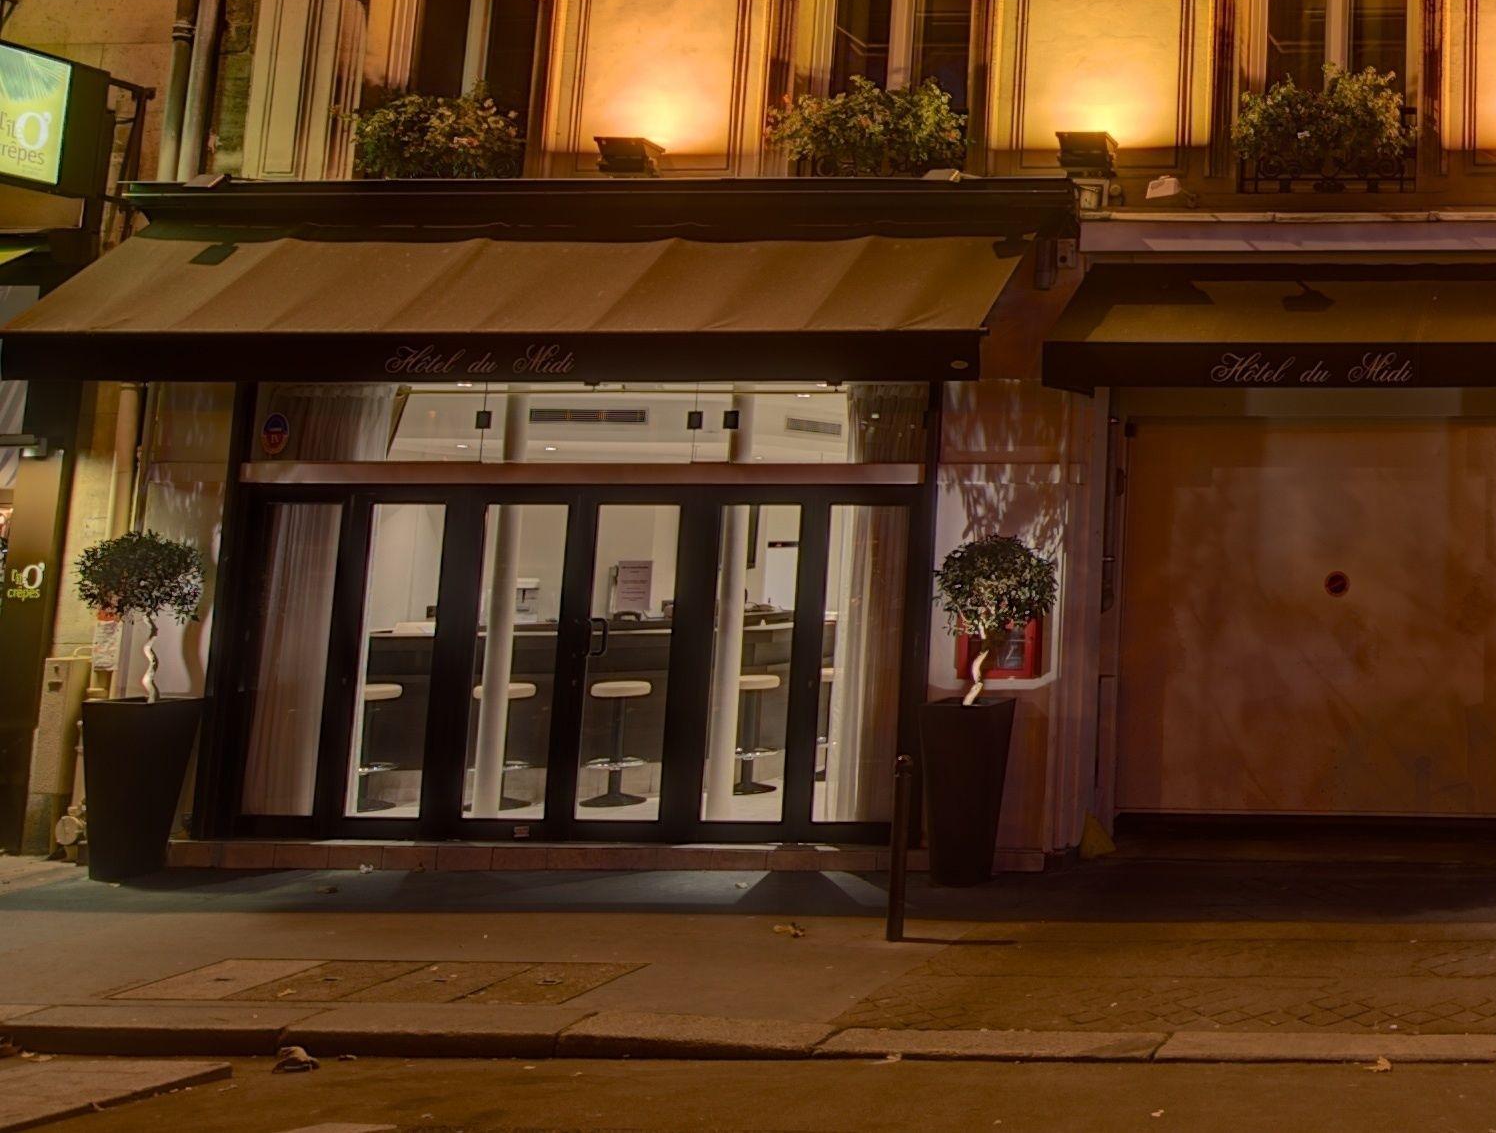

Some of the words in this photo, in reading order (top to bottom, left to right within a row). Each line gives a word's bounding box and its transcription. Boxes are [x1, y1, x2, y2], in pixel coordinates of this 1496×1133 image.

[0, 141, 46, 166] rêpes
[384, 344, 467, 374] Hôtel
[467, 352, 499, 374] du
[512, 344, 576, 374] Midi
[1210, 352, 1296, 383] Hôtel
[1299, 360, 1332, 383] du
[1347, 352, 1414, 383] Midi
